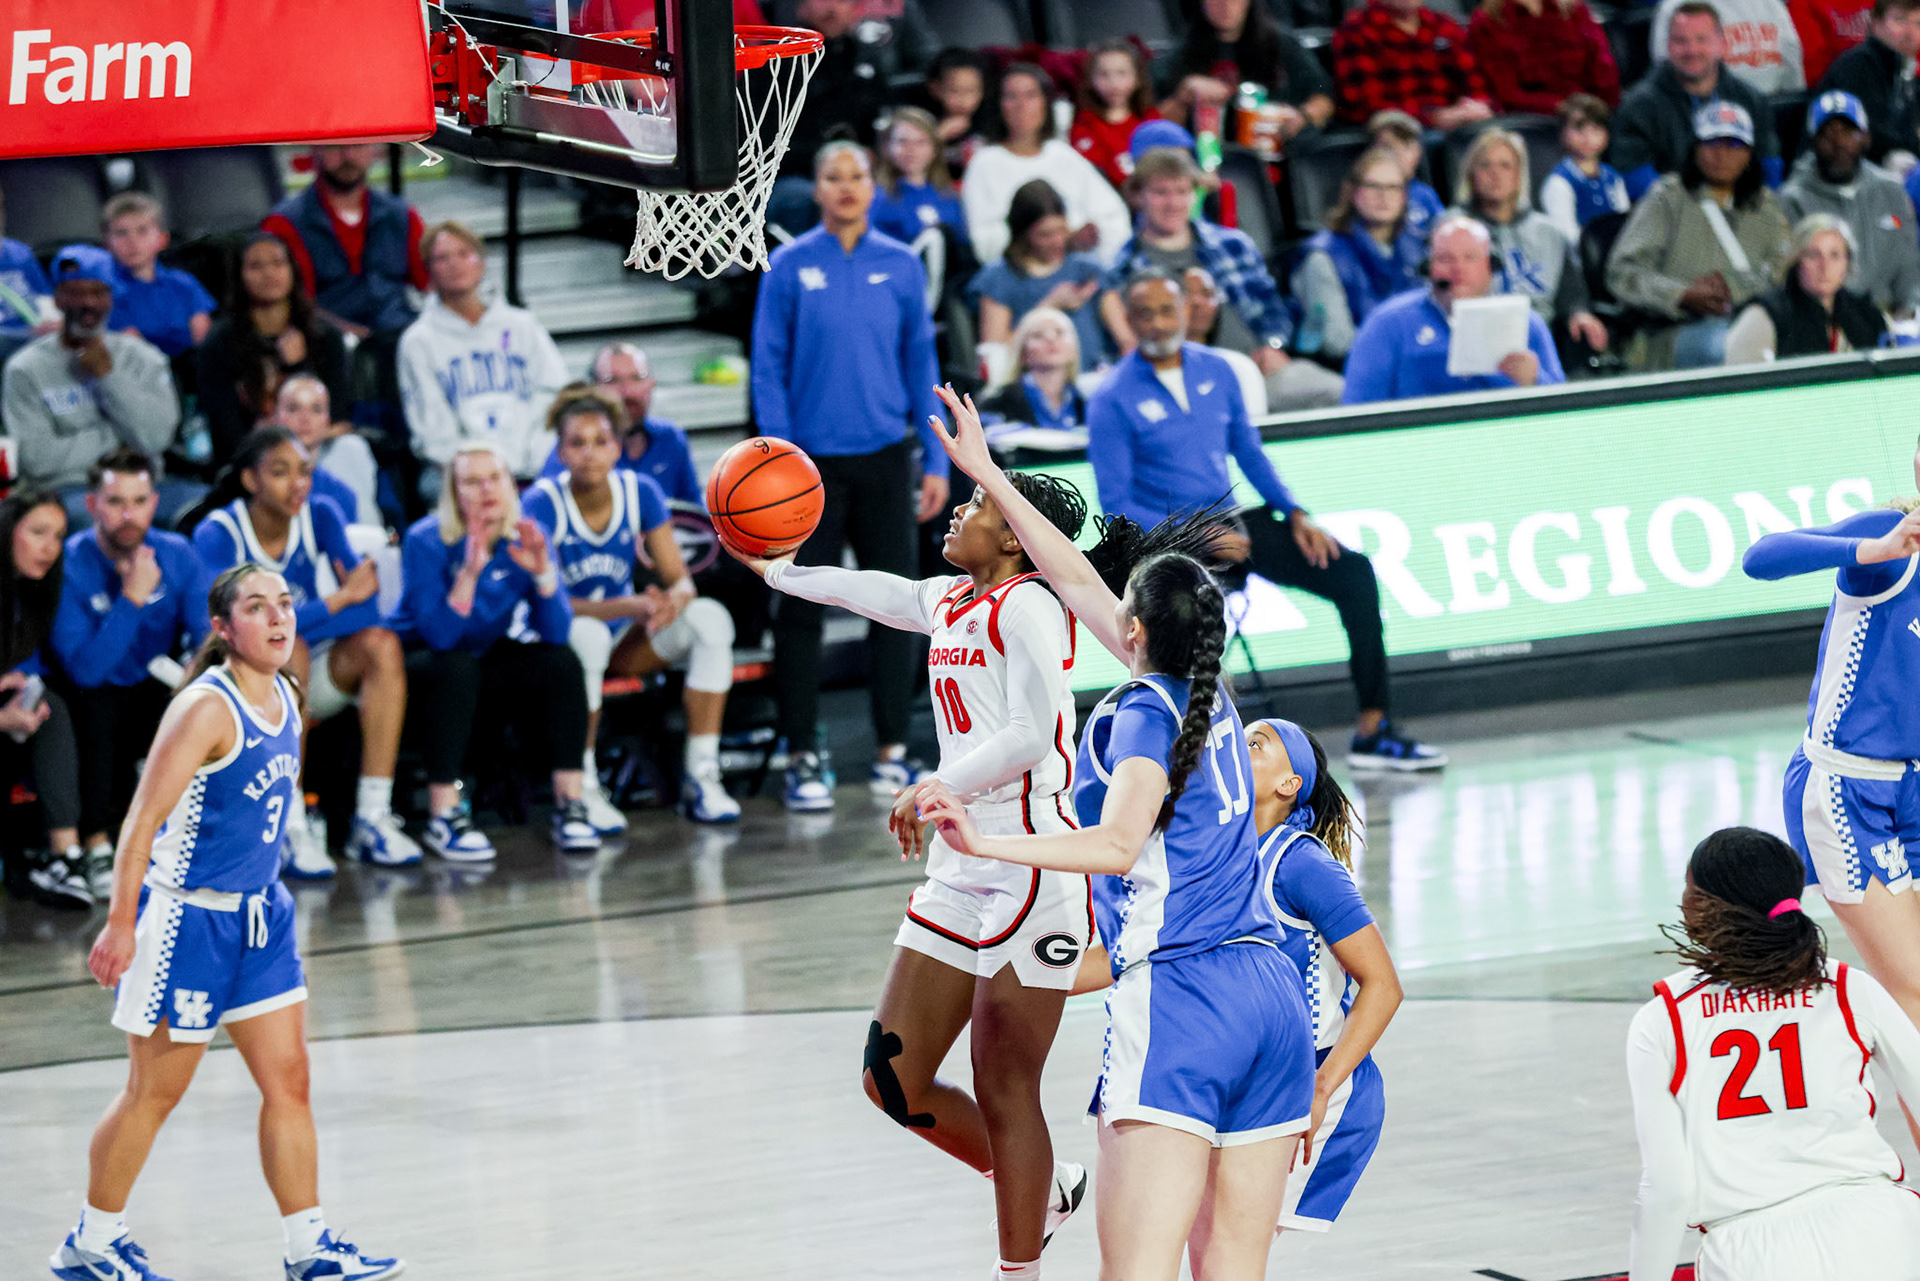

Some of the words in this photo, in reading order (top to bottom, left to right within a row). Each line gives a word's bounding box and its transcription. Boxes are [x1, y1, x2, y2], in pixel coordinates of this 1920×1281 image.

[9, 29, 192, 105] Farm
[928, 647, 987, 667] EORGIA
[935, 677, 972, 735] 10
[262, 795, 284, 844] 3
[1871, 836, 1909, 880] UK
[1034, 934, 1079, 966] G
[174, 988, 214, 1028] UK
[1710, 1022, 1808, 1121] 21
